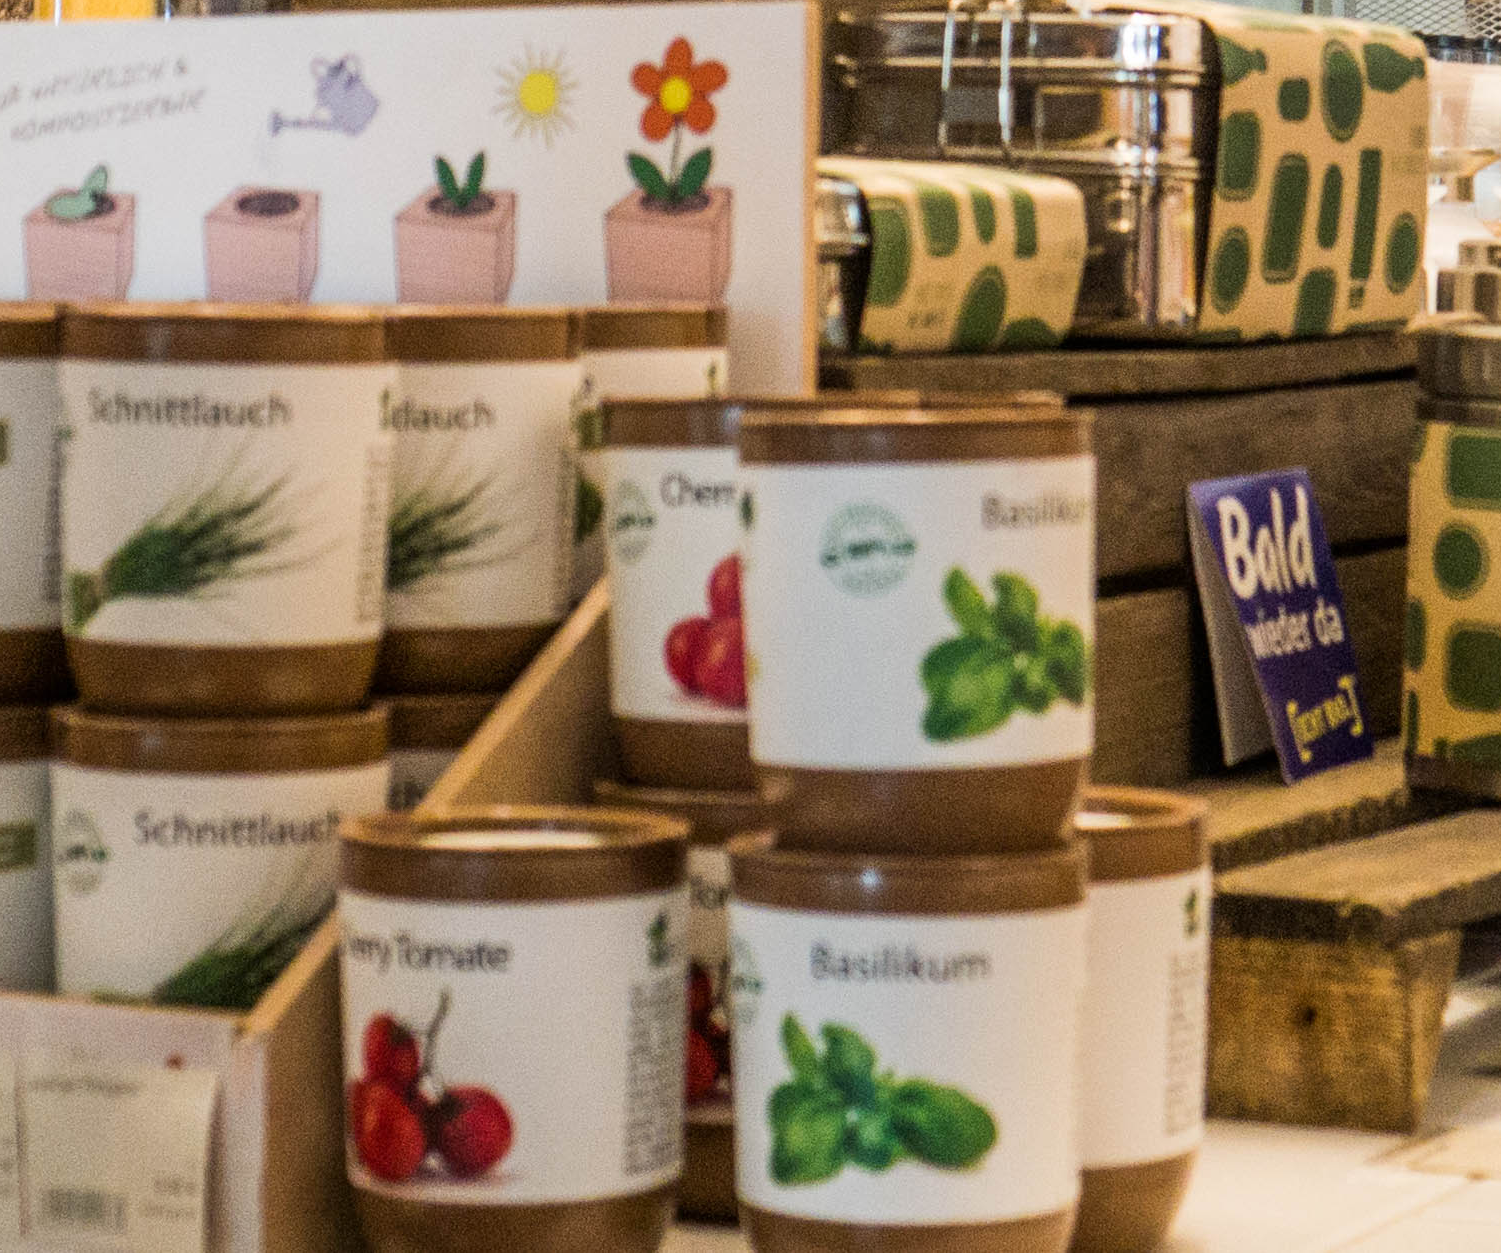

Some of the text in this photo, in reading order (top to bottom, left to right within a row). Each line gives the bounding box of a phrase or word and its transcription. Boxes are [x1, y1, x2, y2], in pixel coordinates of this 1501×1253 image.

[89, 387, 292, 428] Schnittlauch
[661, 471, 736, 510] Cherr
[1217, 485, 1317, 599] Bald
[1246, 599, 1344, 660] wieder da
[395, 930, 512, 971] Tomate
[810, 940, 990, 984] Basilikum
